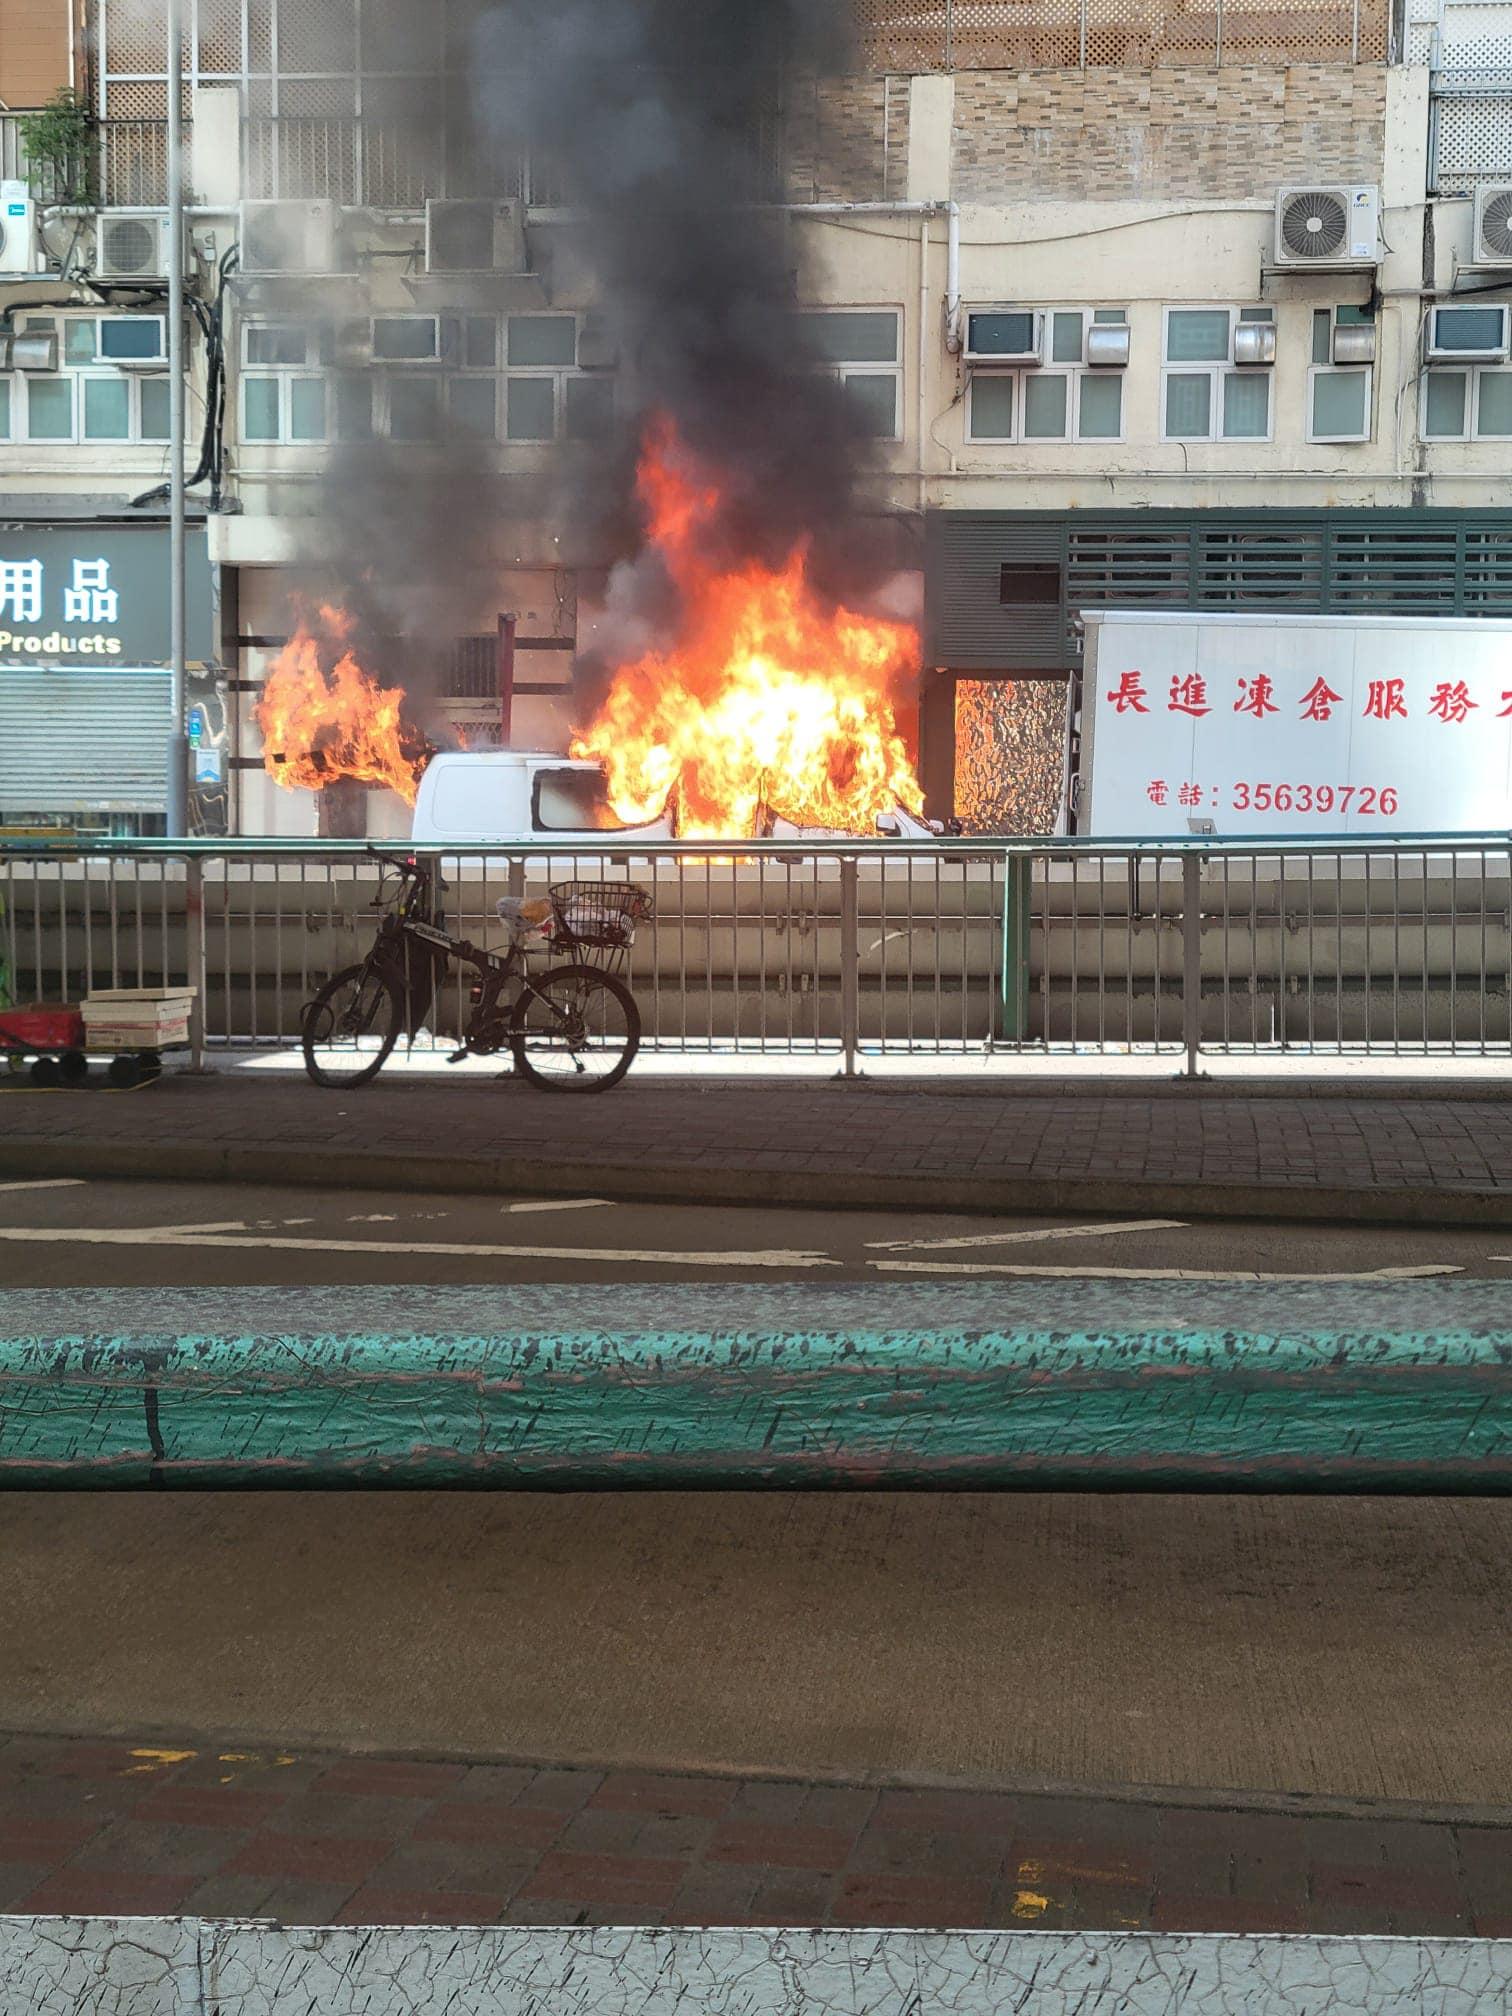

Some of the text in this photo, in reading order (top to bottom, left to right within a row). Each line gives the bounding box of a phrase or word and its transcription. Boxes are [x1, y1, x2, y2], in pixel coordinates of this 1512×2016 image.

[0, 558, 119, 623] 用品
[0, 631, 121, 654] Products
[1232, 782, 1399, 816] 35639726
